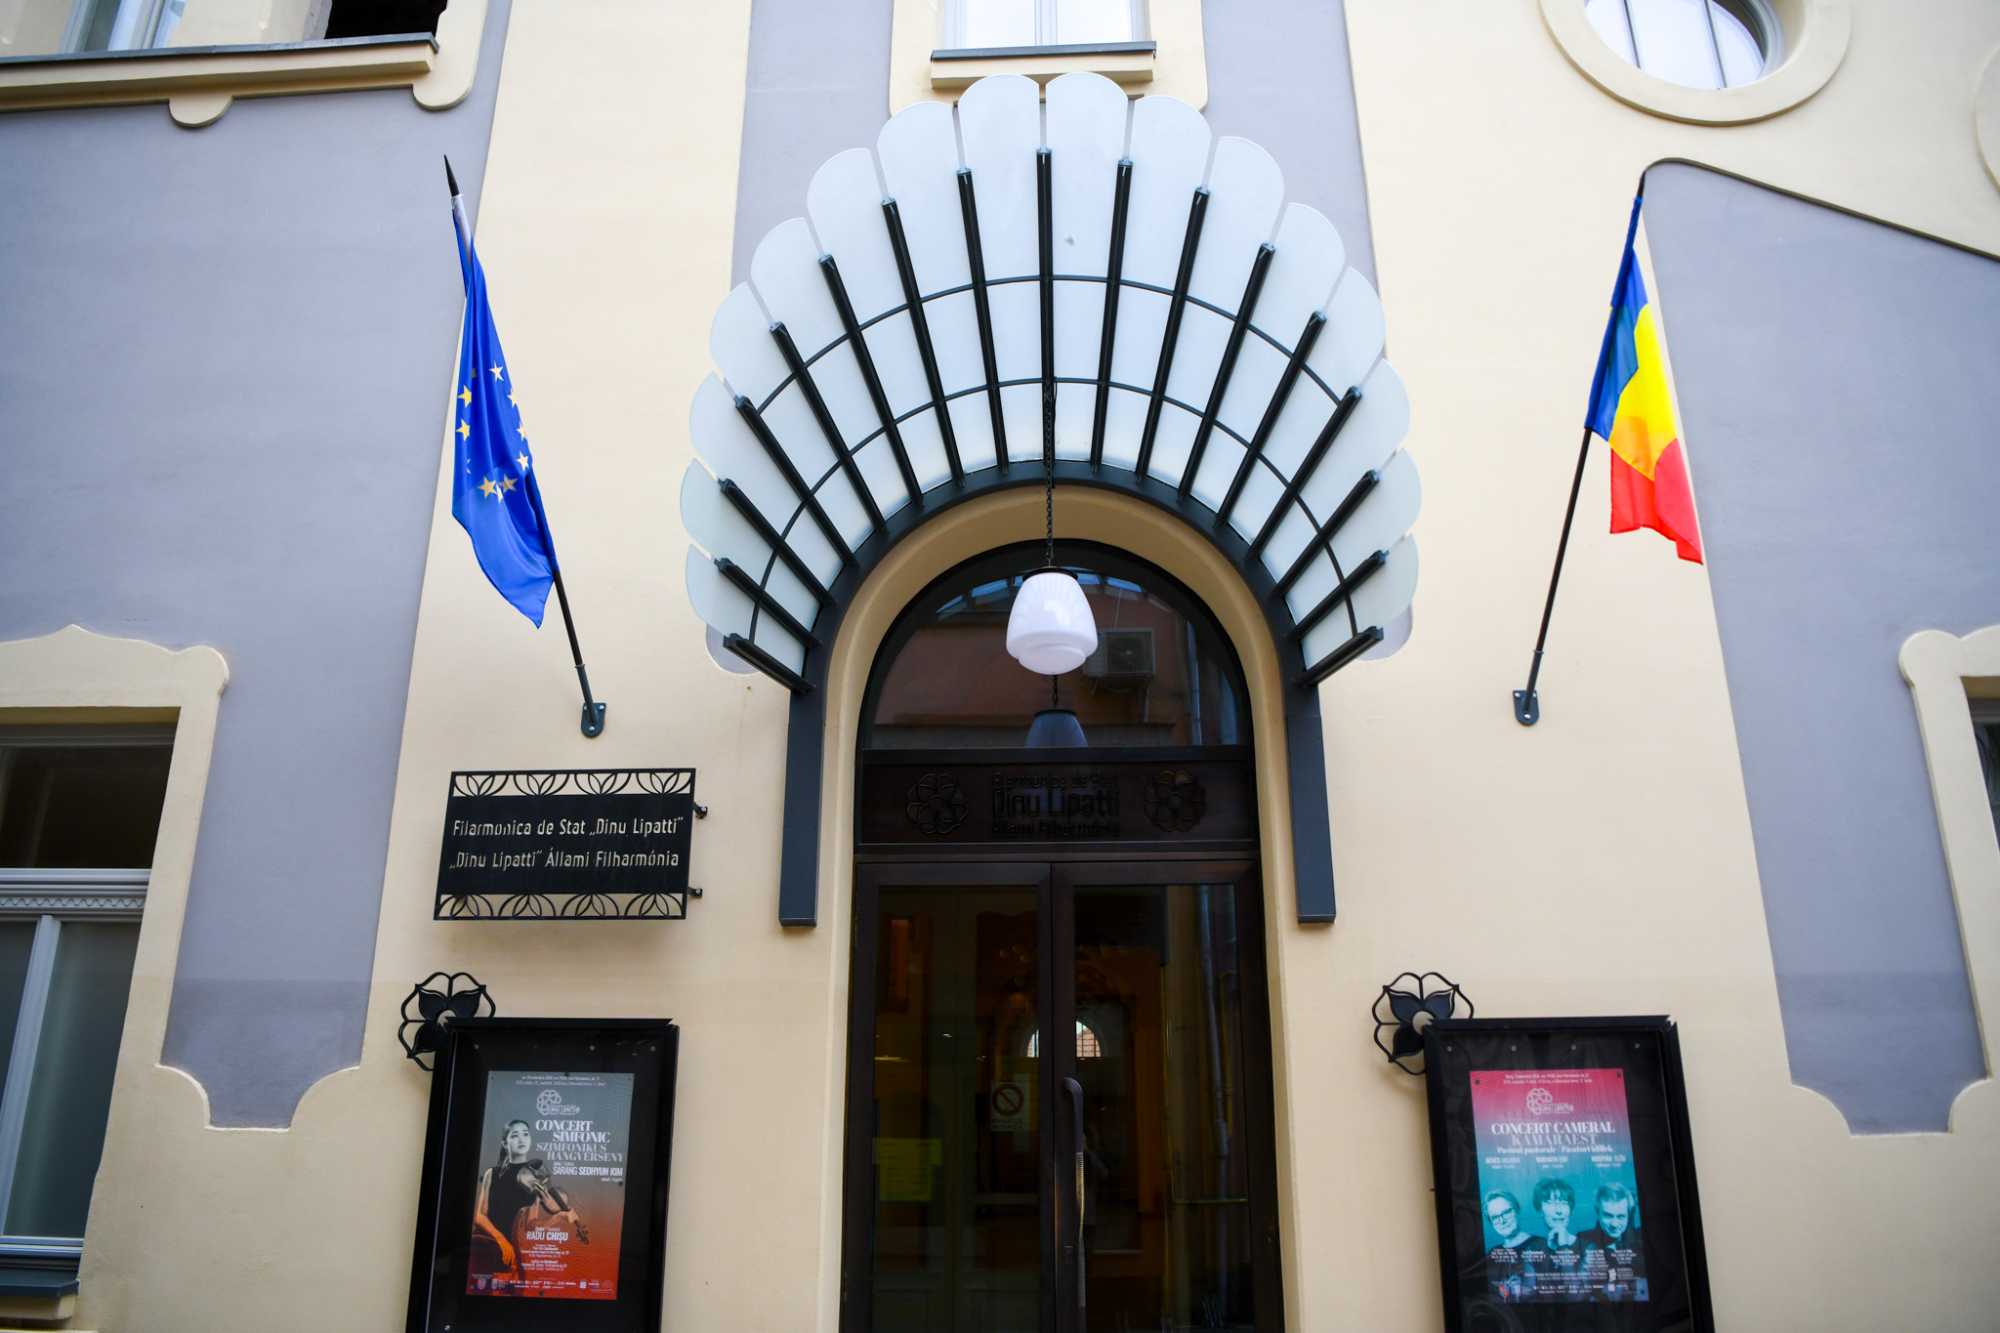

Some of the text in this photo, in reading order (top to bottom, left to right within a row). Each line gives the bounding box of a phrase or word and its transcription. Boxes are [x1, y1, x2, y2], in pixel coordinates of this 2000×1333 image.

[453, 818, 532, 836] Filarmonica
[537, 818, 554, 836] de
[559, 818, 586, 835] Stat
[545, 847, 590, 868] Állami
[595, 849, 679, 868] Filharmónia
[535, 1119, 593, 1131] CONCERT
[1491, 1121, 1616, 1135] CONCERT CAMERAL
[552, 1131, 611, 1143] SIMFONIC
